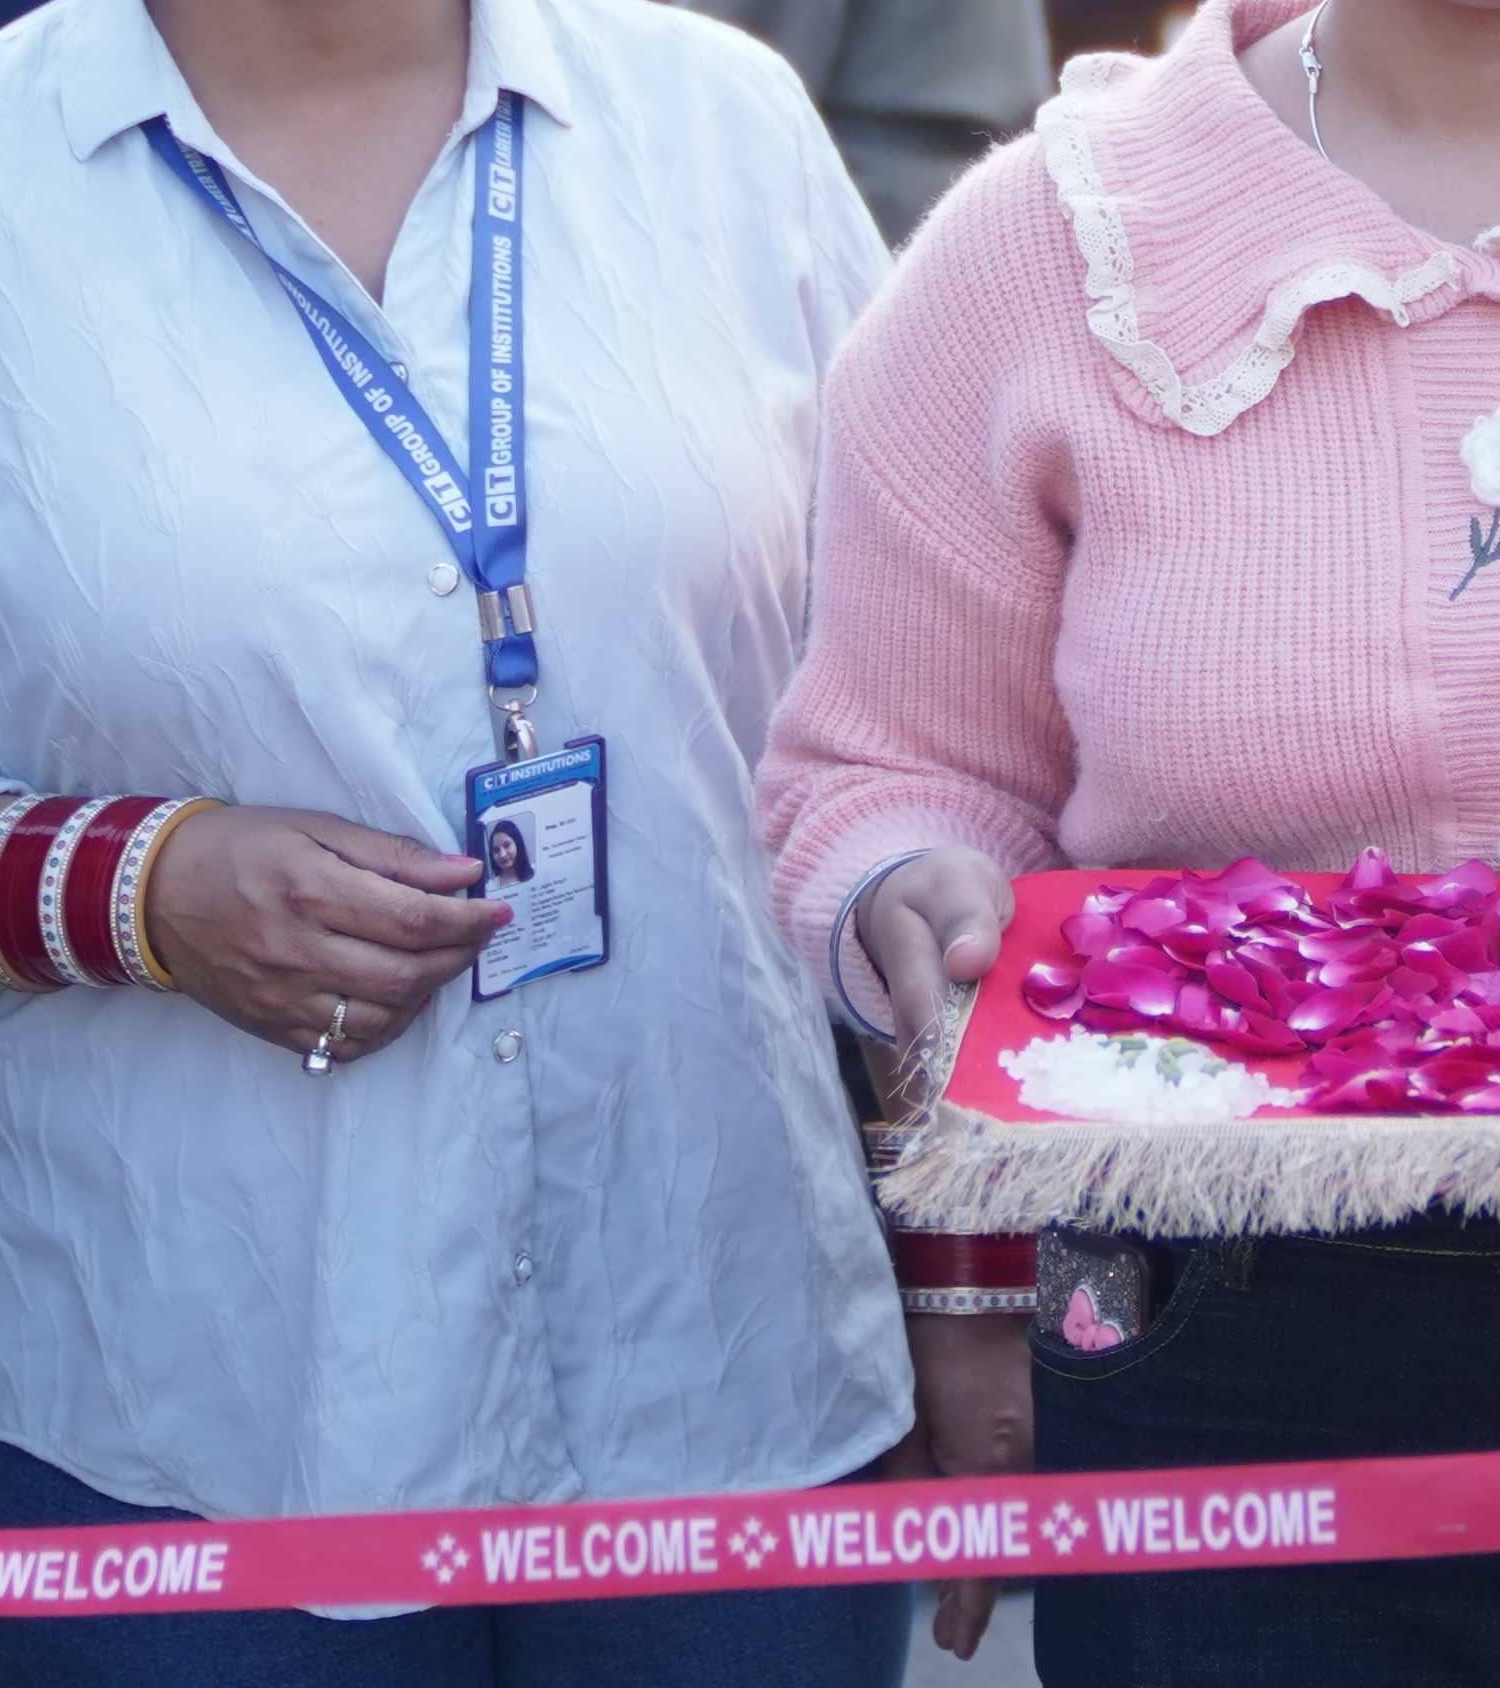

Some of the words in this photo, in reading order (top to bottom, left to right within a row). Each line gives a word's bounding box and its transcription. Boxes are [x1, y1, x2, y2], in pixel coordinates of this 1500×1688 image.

[491, 235, 513, 364] INSTITUTIONS
[364, 387, 394, 413] OF
[490, 368, 513, 394] OF
[384, 414, 442, 478] GROUP
[490, 397, 513, 465] GROUP
[510, 750, 592, 781] INSTITUTIONS
[479, 1516, 719, 1584] WELCOME
[787, 1500, 1030, 1569] WELCOME
[1096, 1489, 1337, 1555] WELCOME
